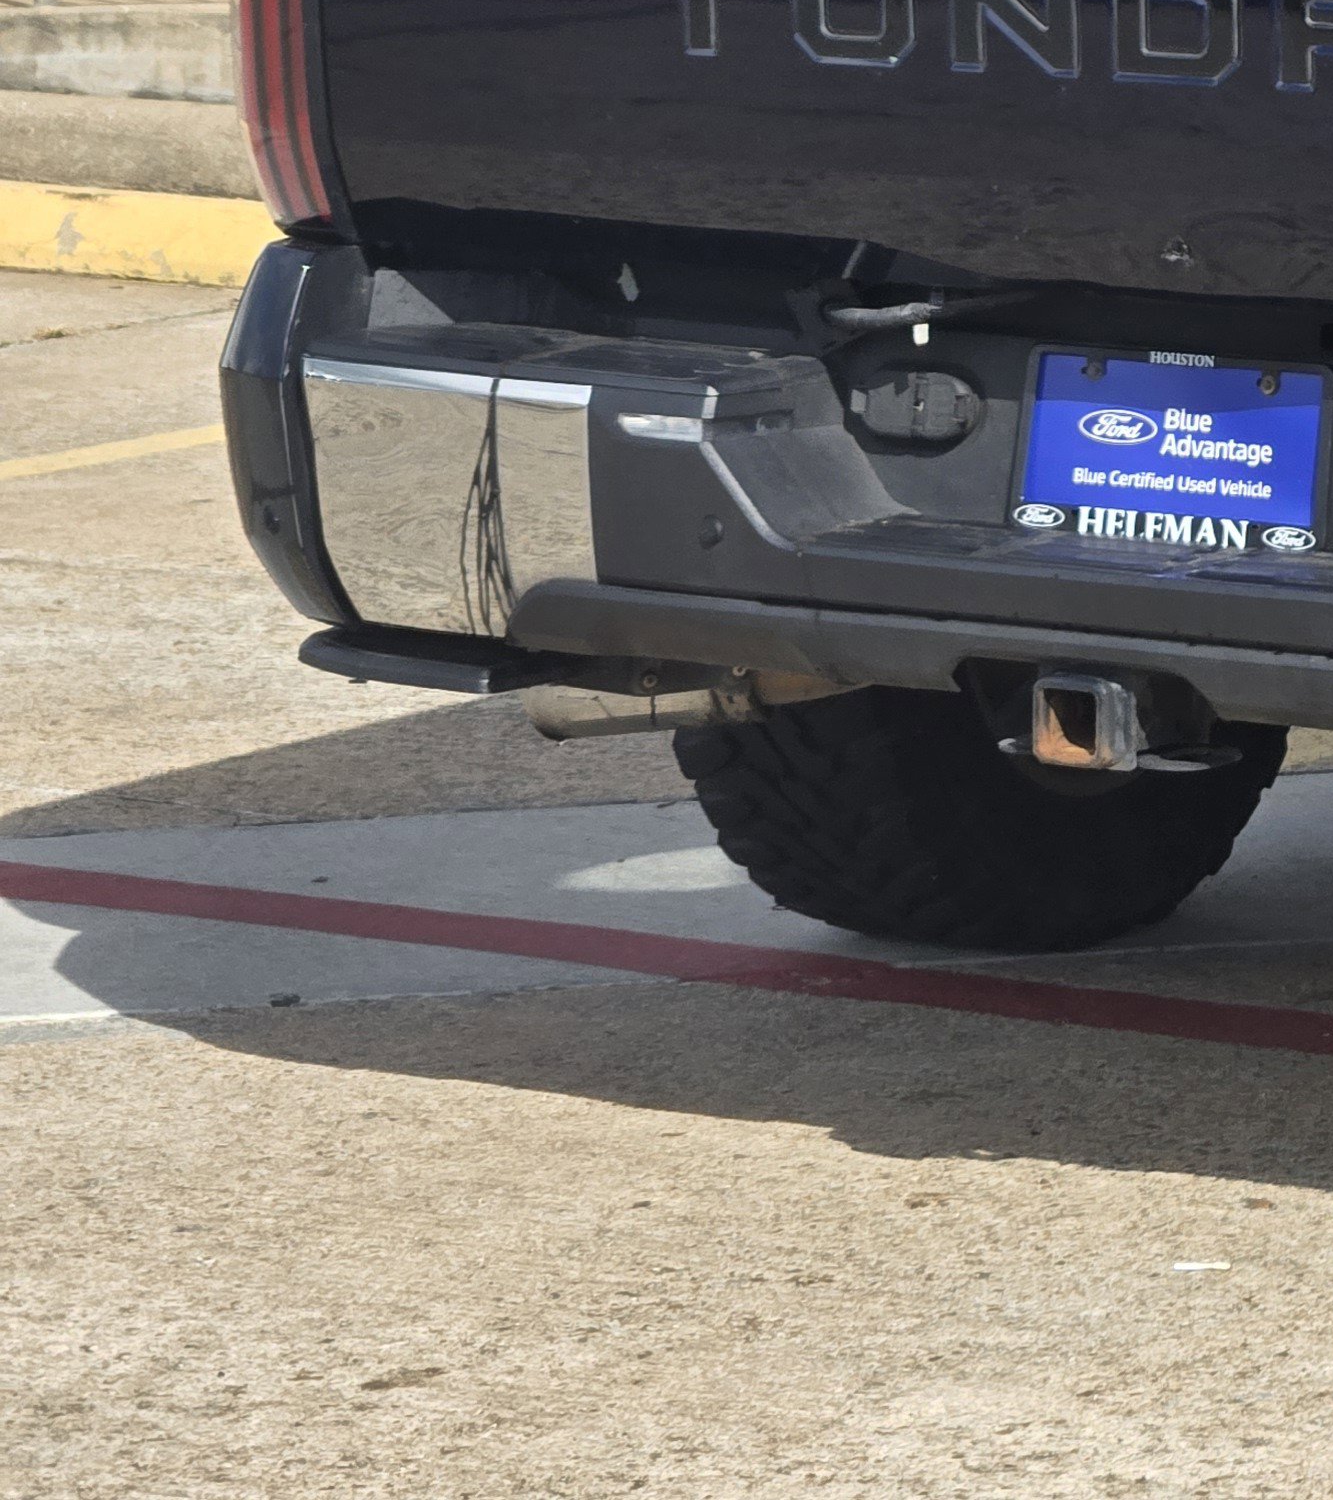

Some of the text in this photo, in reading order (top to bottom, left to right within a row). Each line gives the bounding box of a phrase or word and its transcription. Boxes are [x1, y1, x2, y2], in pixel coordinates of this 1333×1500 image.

[1149, 351, 1215, 368] HOUSTON
[1163, 407, 1213, 433] Blue
[1159, 433, 1273, 468] Advantage
[1072, 466, 1272, 500] Blue Certified Used Vehicle
[1076, 505, 1250, 550] HELFMAN
